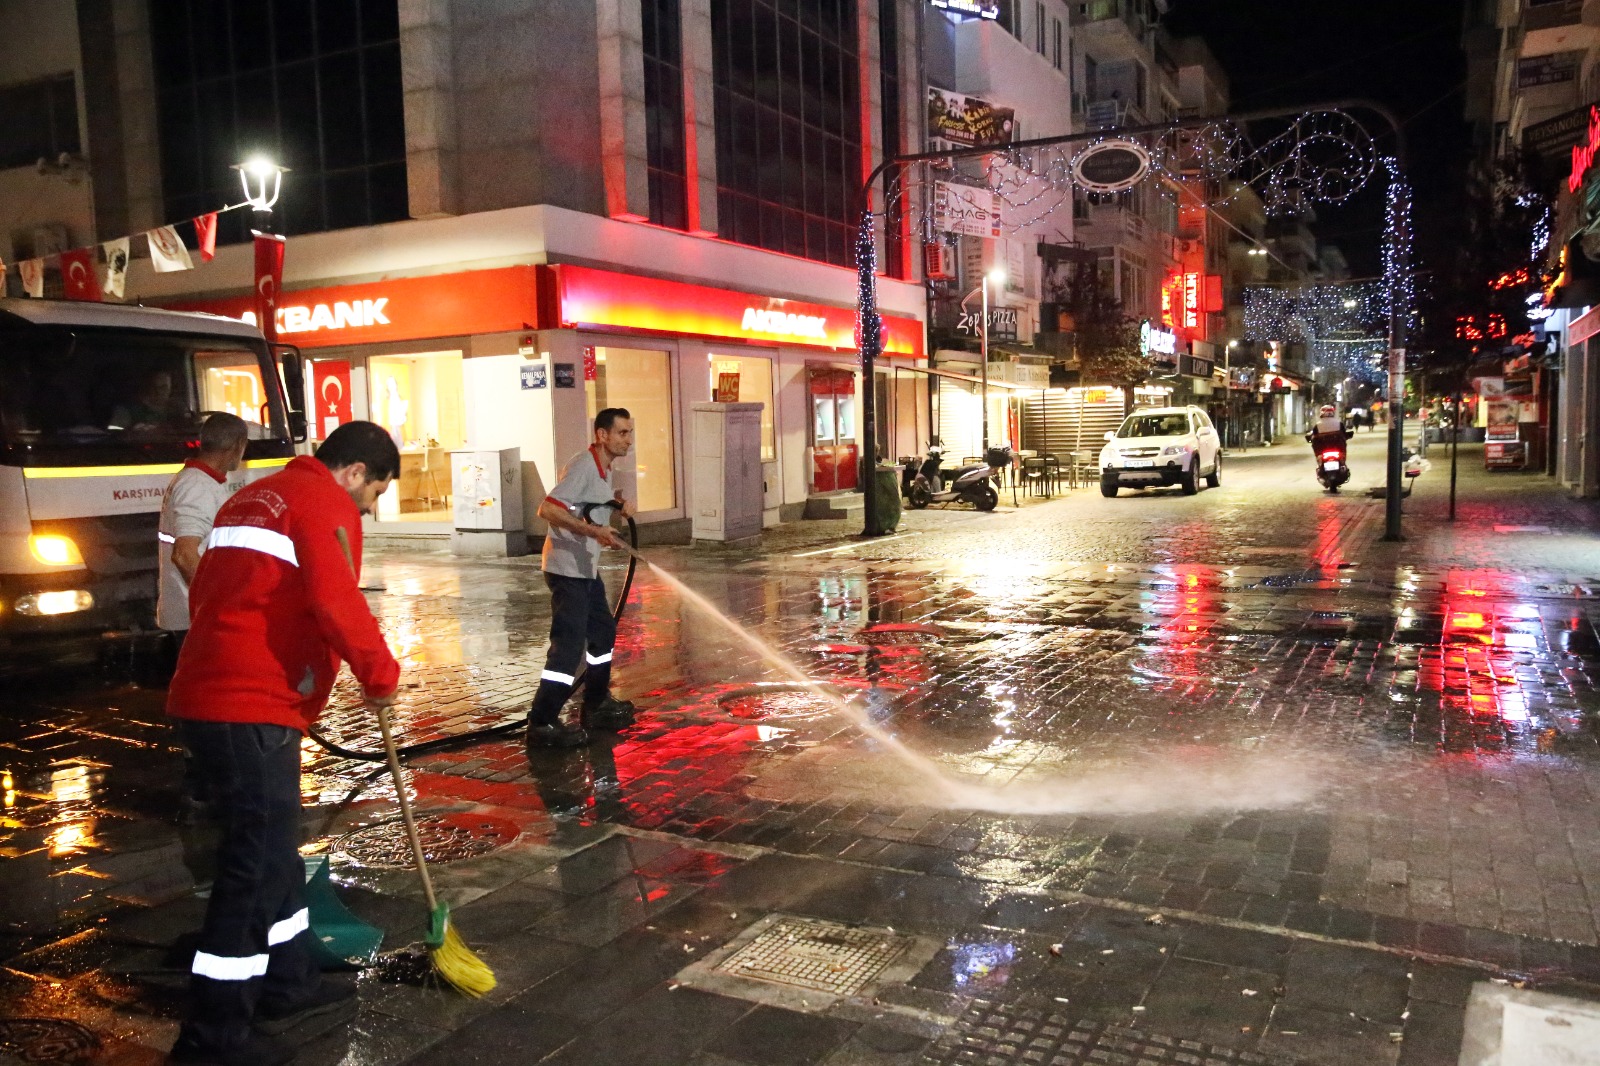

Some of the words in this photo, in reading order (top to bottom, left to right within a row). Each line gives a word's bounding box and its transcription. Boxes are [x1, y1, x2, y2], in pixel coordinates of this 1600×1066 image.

[741, 307, 828, 339] AKBANK
[993, 311, 1017, 325] PIZZA
[1187, 310, 1196, 327] BY
[720, 377, 739, 393] WC
